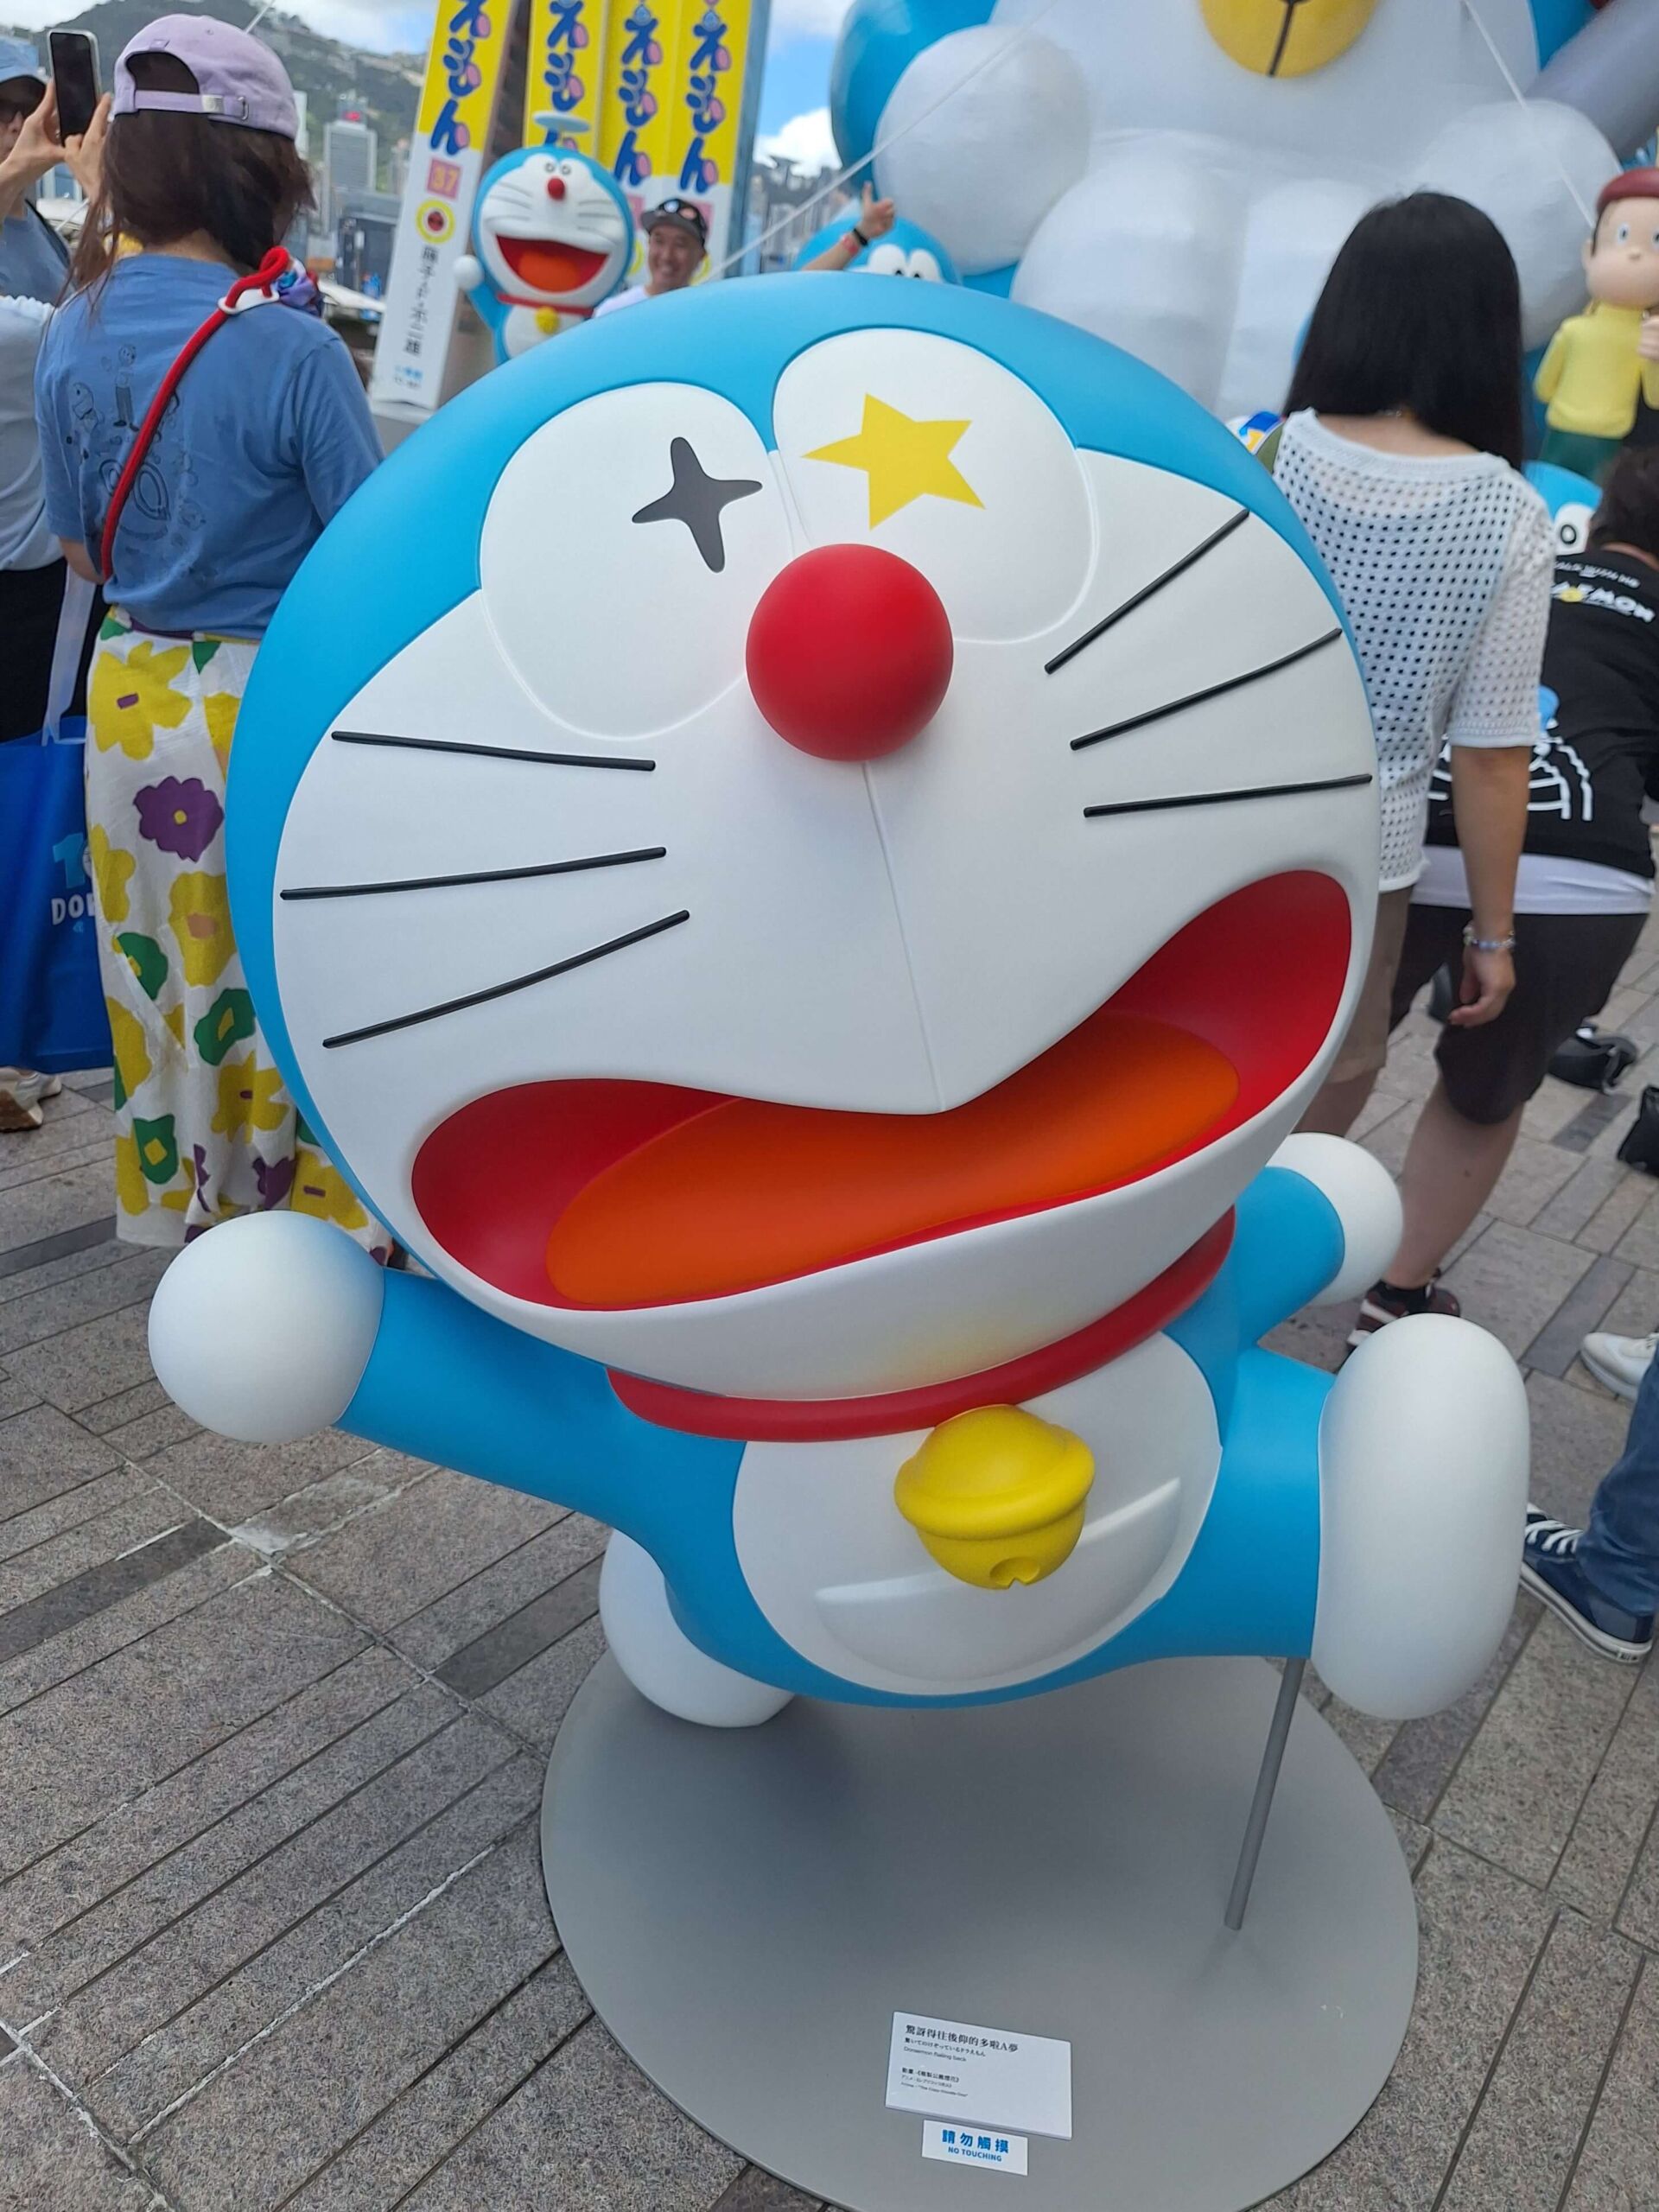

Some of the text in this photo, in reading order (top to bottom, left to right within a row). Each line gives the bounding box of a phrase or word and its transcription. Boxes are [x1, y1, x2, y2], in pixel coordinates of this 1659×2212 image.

[942, 2129, 1009, 2154] 請勿觸摸
[961, 2148, 1002, 2162] TOUCHING
